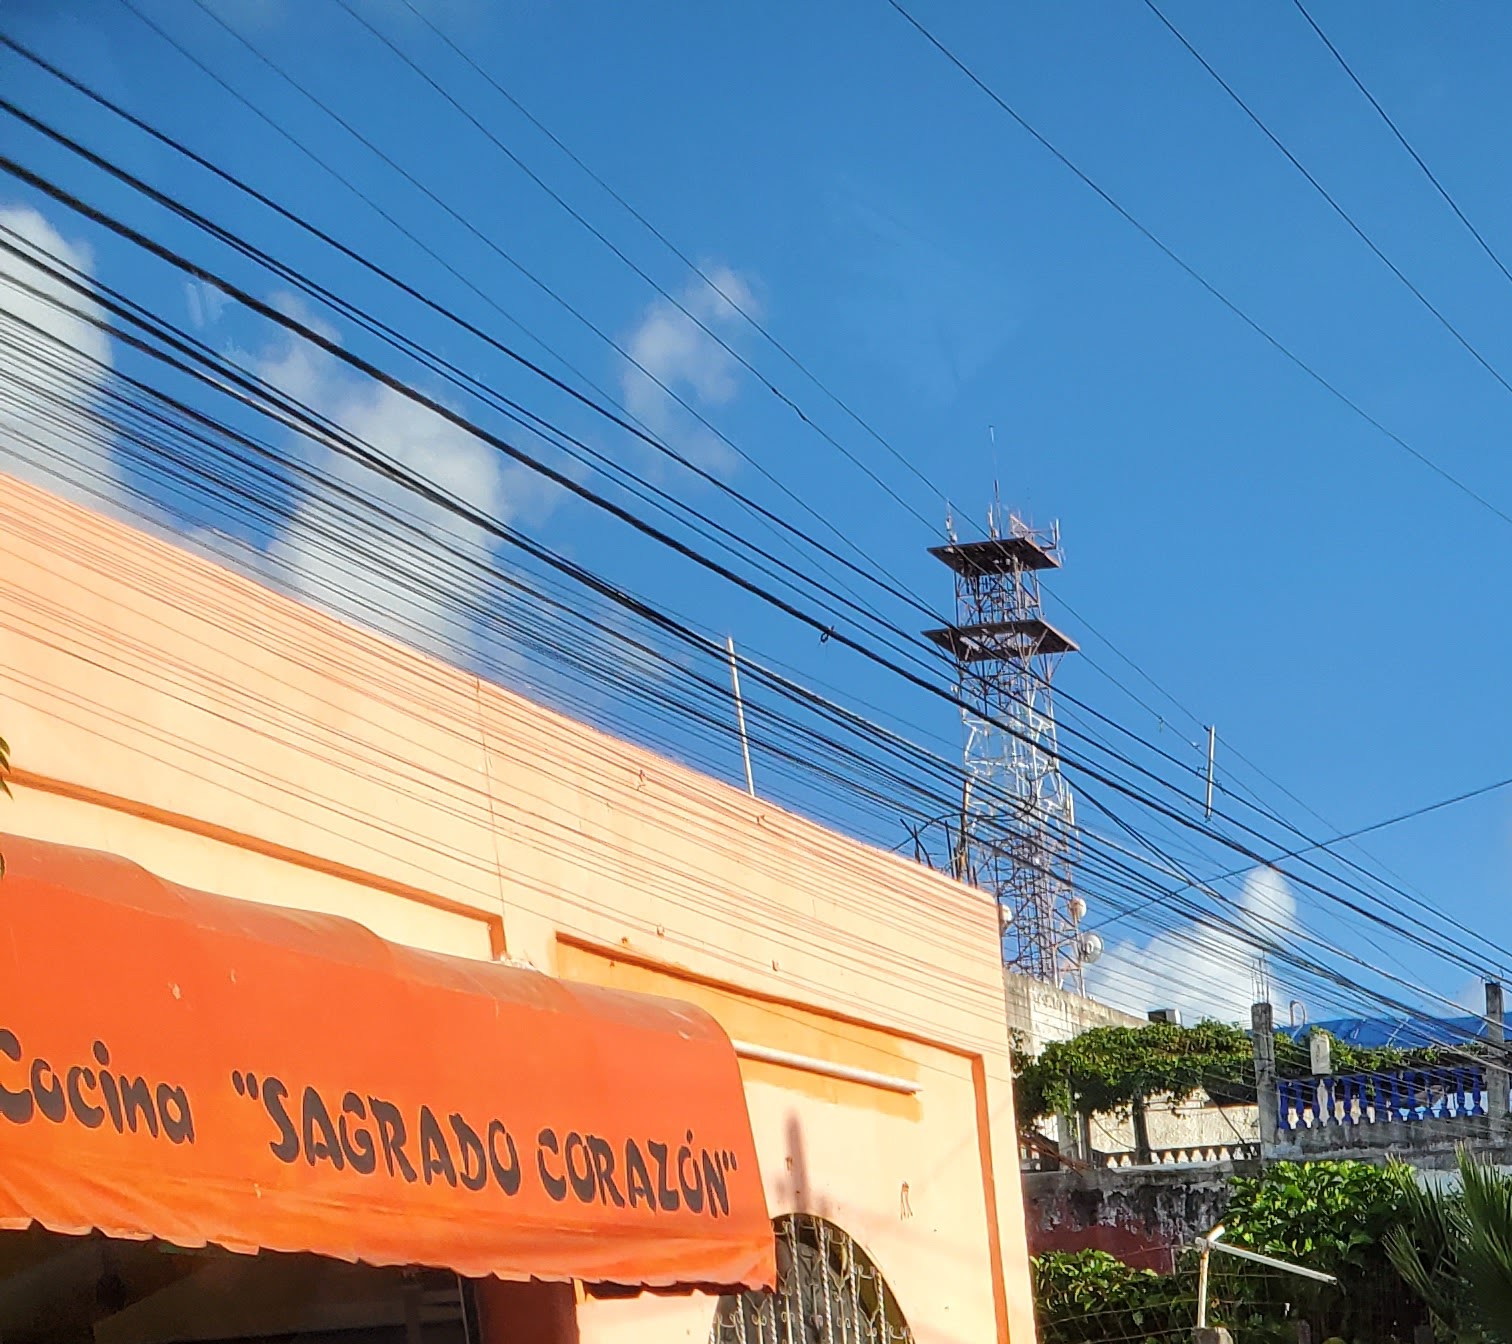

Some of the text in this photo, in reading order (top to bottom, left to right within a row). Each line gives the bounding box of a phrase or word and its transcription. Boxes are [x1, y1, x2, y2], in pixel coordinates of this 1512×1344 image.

[0, 1028, 738, 1218] Cocina "SAGRADO CORAZÓN"
